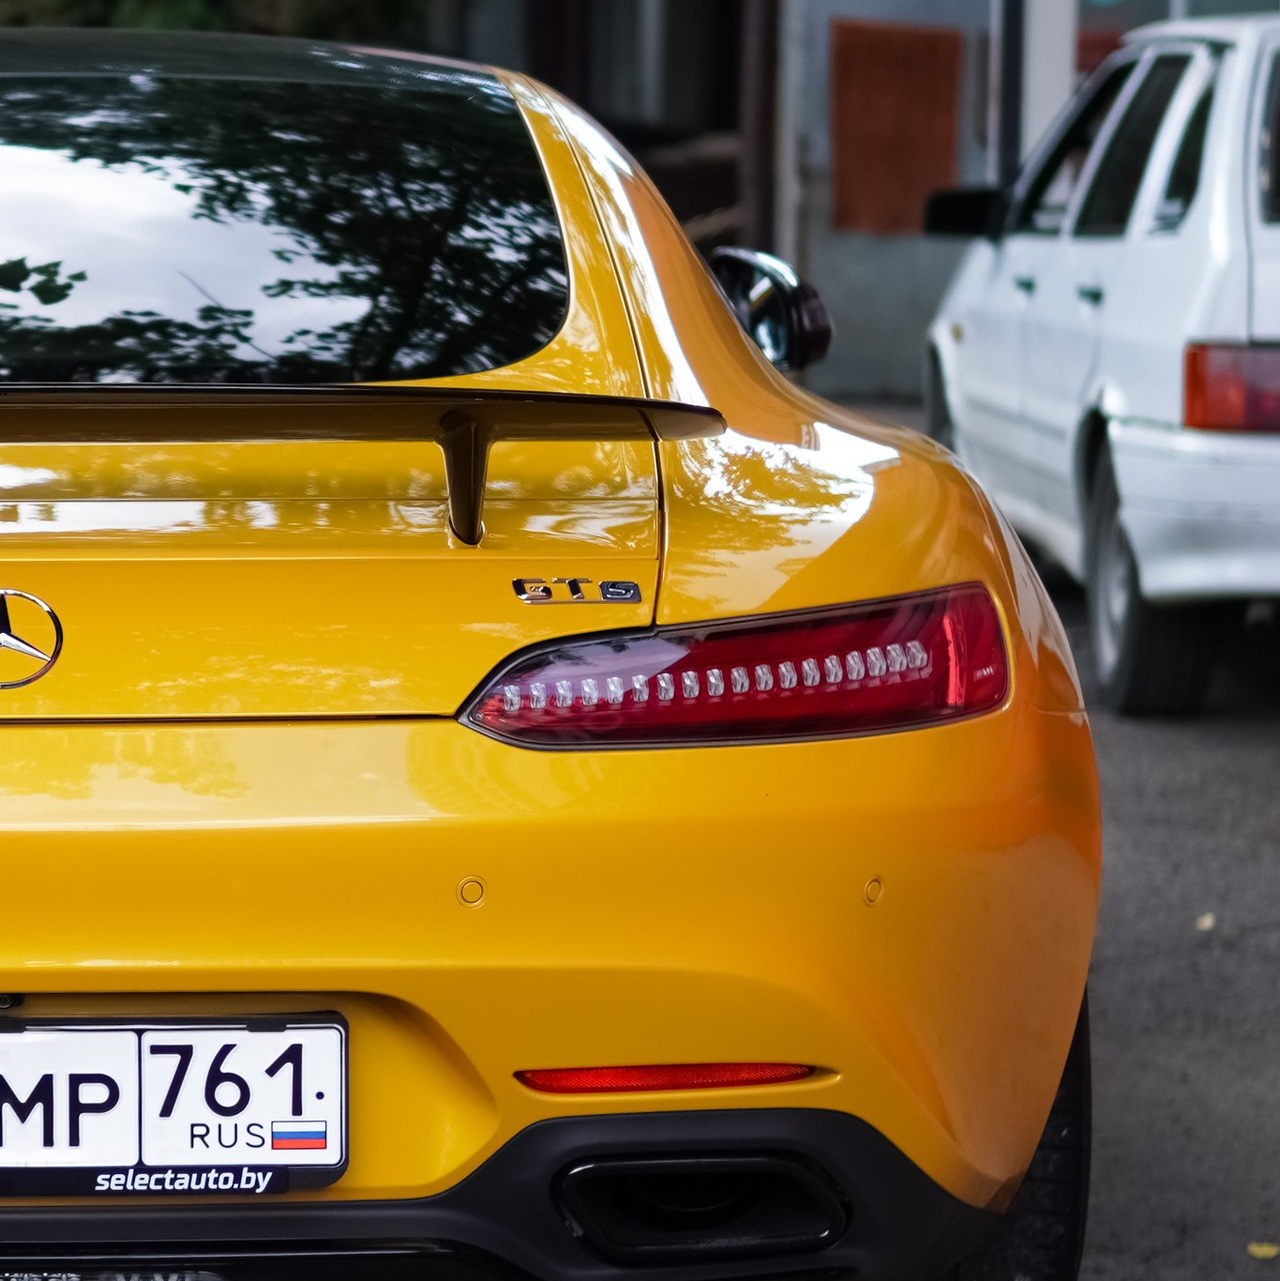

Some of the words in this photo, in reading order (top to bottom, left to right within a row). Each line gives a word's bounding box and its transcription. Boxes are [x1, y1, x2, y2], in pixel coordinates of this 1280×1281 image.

[149, 1043, 303, 1118] 761
[190, 1122, 266, 1149] RUS
[95, 1167, 273, 1194] selectauto.by
